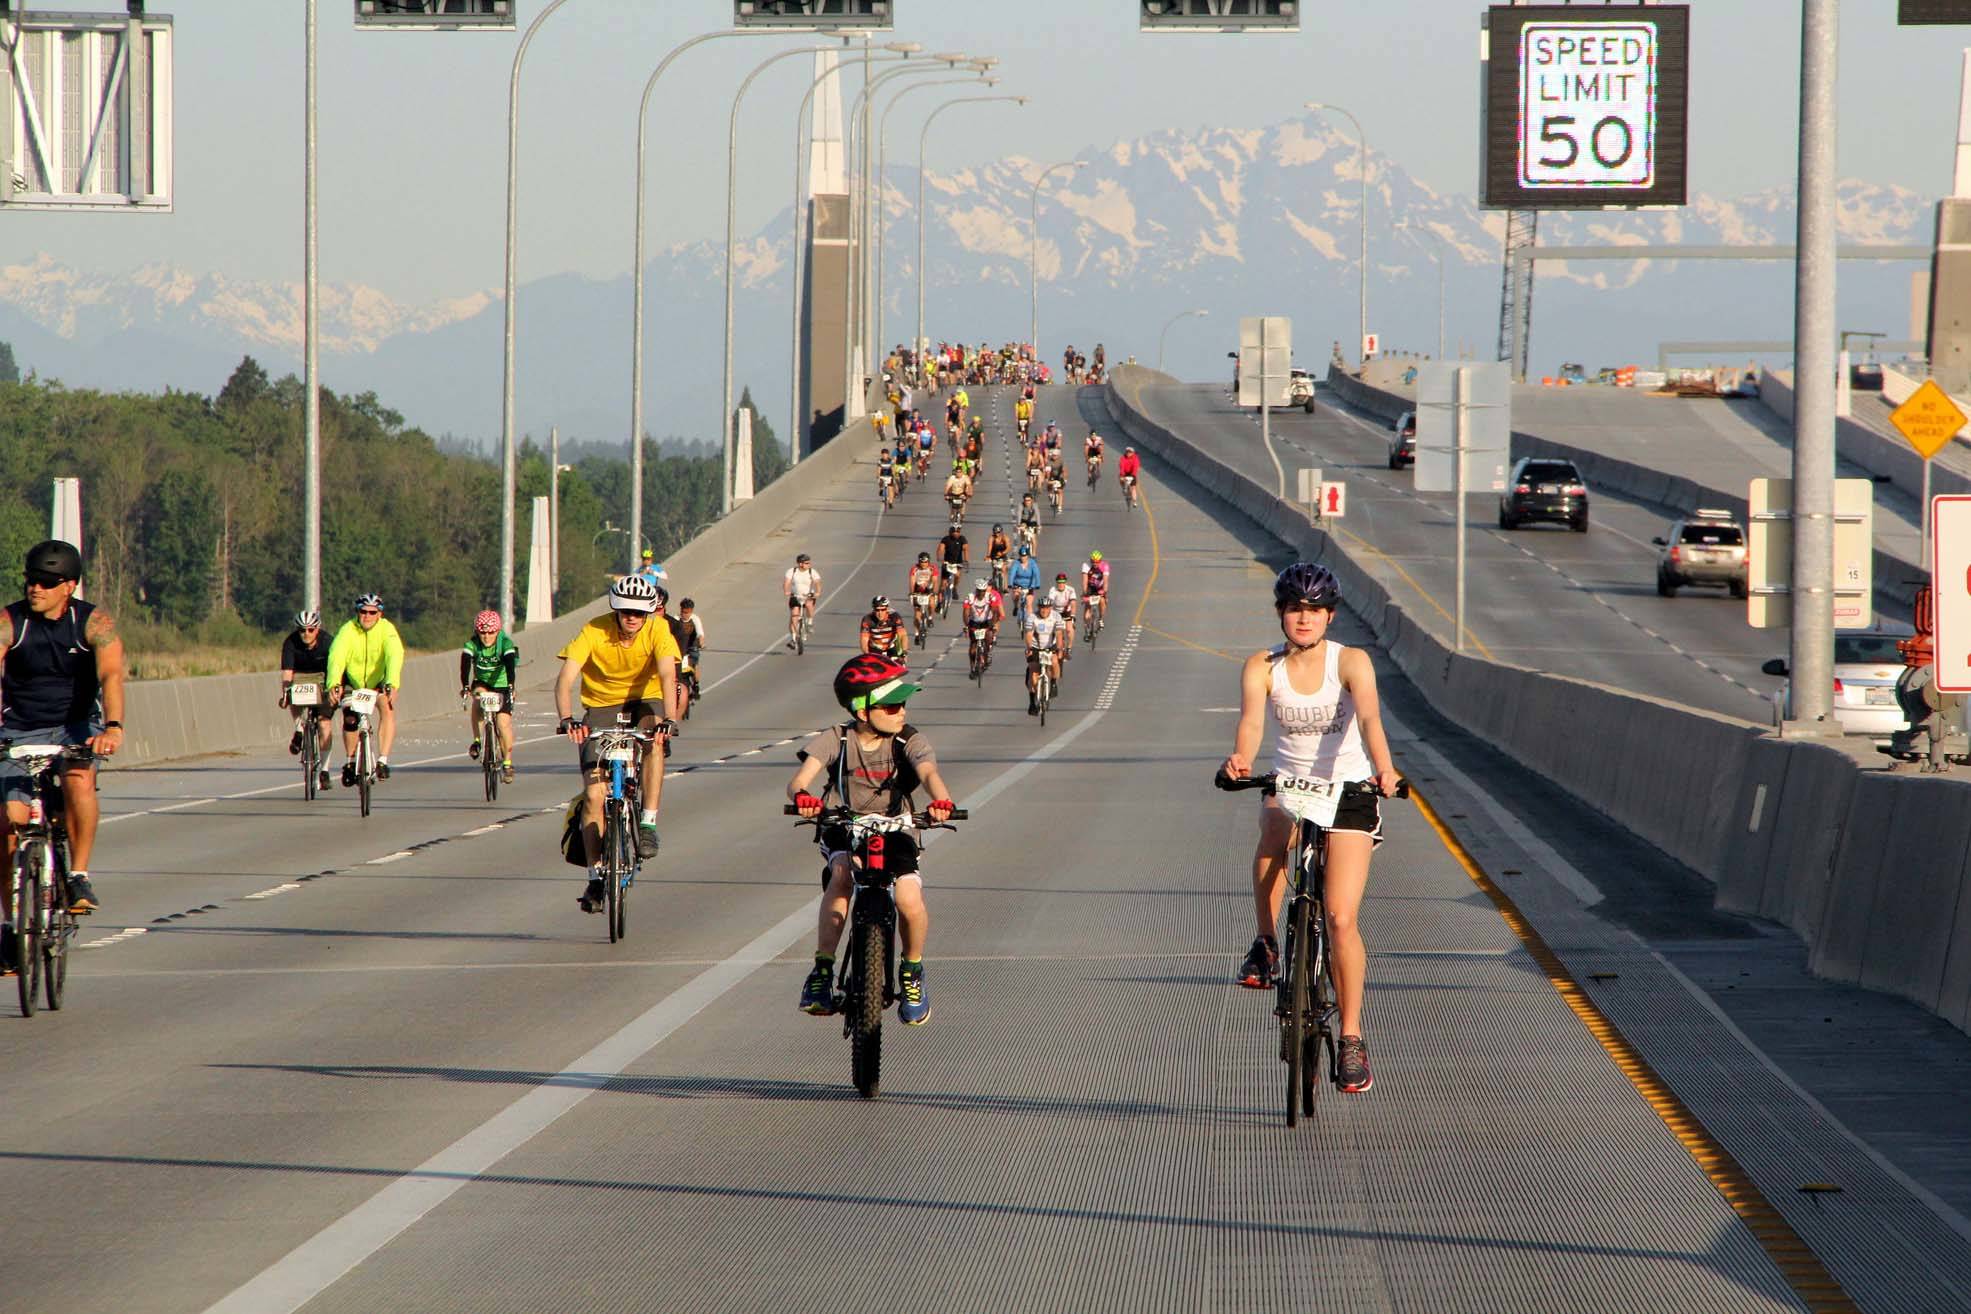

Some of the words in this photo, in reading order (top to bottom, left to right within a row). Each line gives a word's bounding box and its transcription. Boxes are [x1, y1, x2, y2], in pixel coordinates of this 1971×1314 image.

[1536, 37, 1642, 65] SPEED
[1540, 73, 1636, 101] LIMIT
[1539, 116, 1633, 168] 50
[294, 685, 314, 694] 2298
[1275, 702, 1346, 722] DOUBLE
